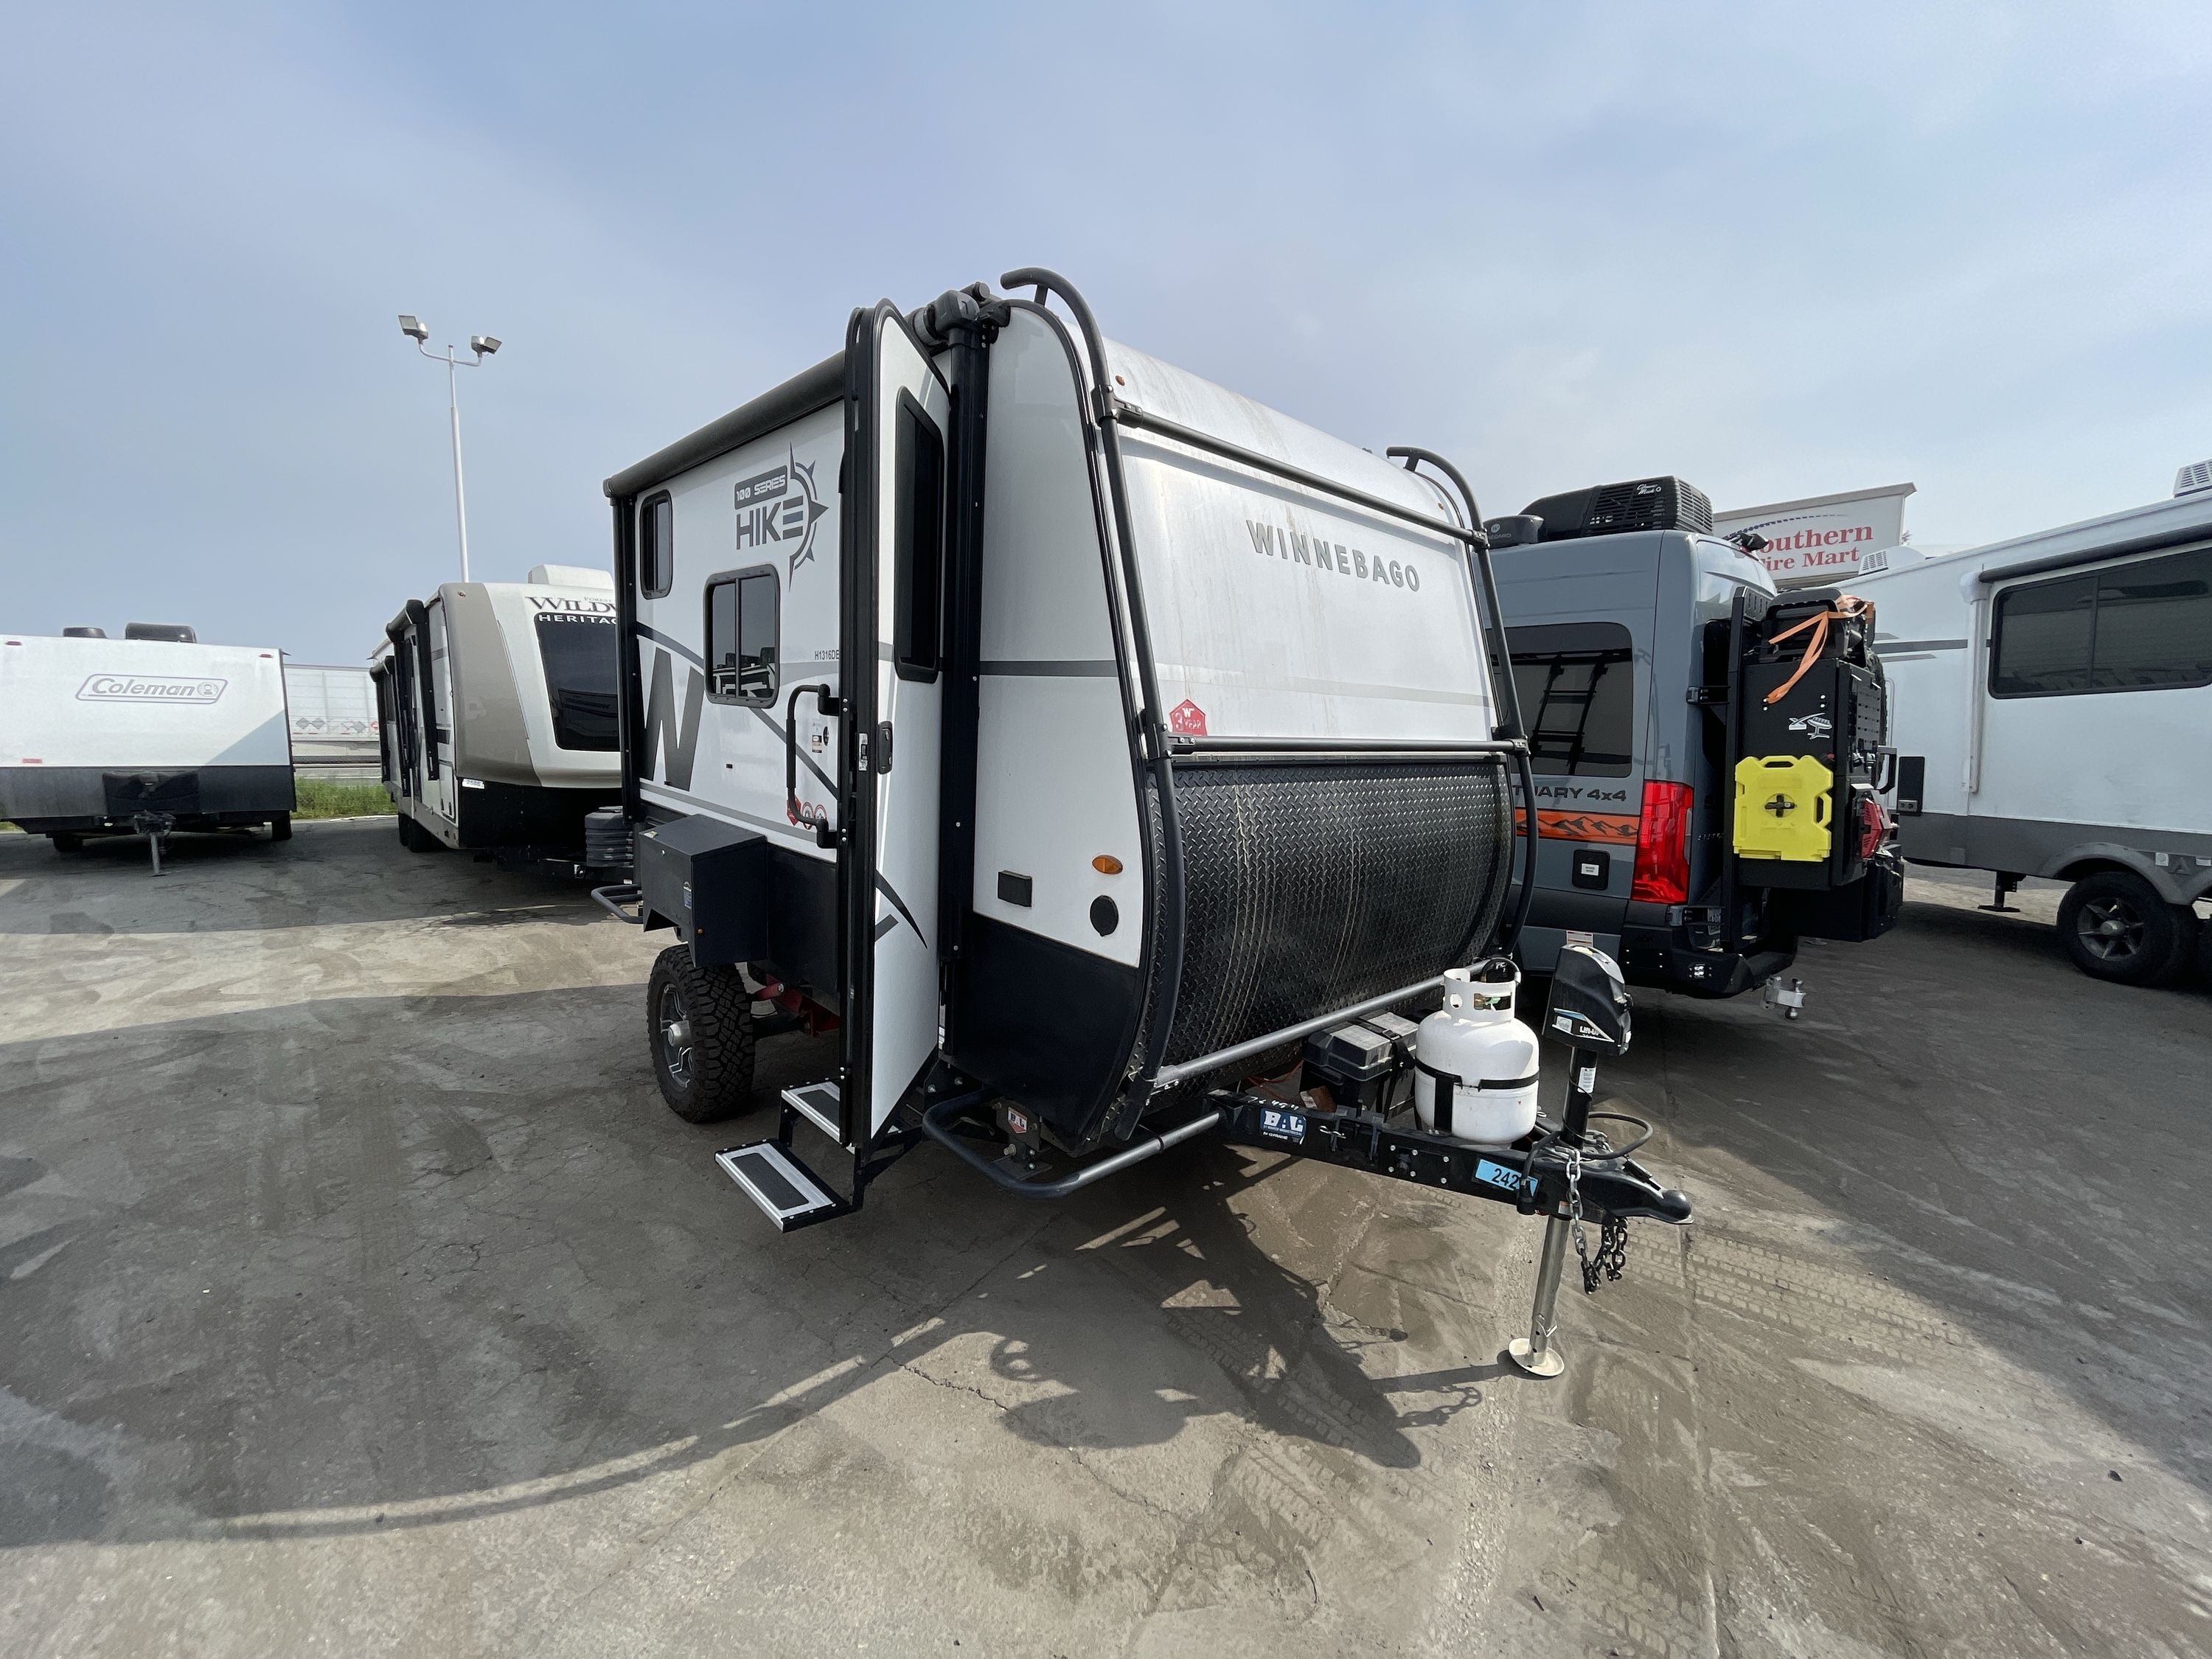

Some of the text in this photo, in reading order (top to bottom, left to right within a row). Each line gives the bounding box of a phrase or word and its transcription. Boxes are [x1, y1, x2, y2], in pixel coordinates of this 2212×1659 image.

[736, 474, 786, 501] 100 SERIES
[736, 495, 804, 550] HIKE
[1759, 526, 1874, 554] outhern
[1245, 519, 1420, 592] WINNEBAGO
[1760, 546, 1860, 571] ire Mart
[91, 678, 196, 697] Coleman
[1587, 788, 1627, 802] 4x4
